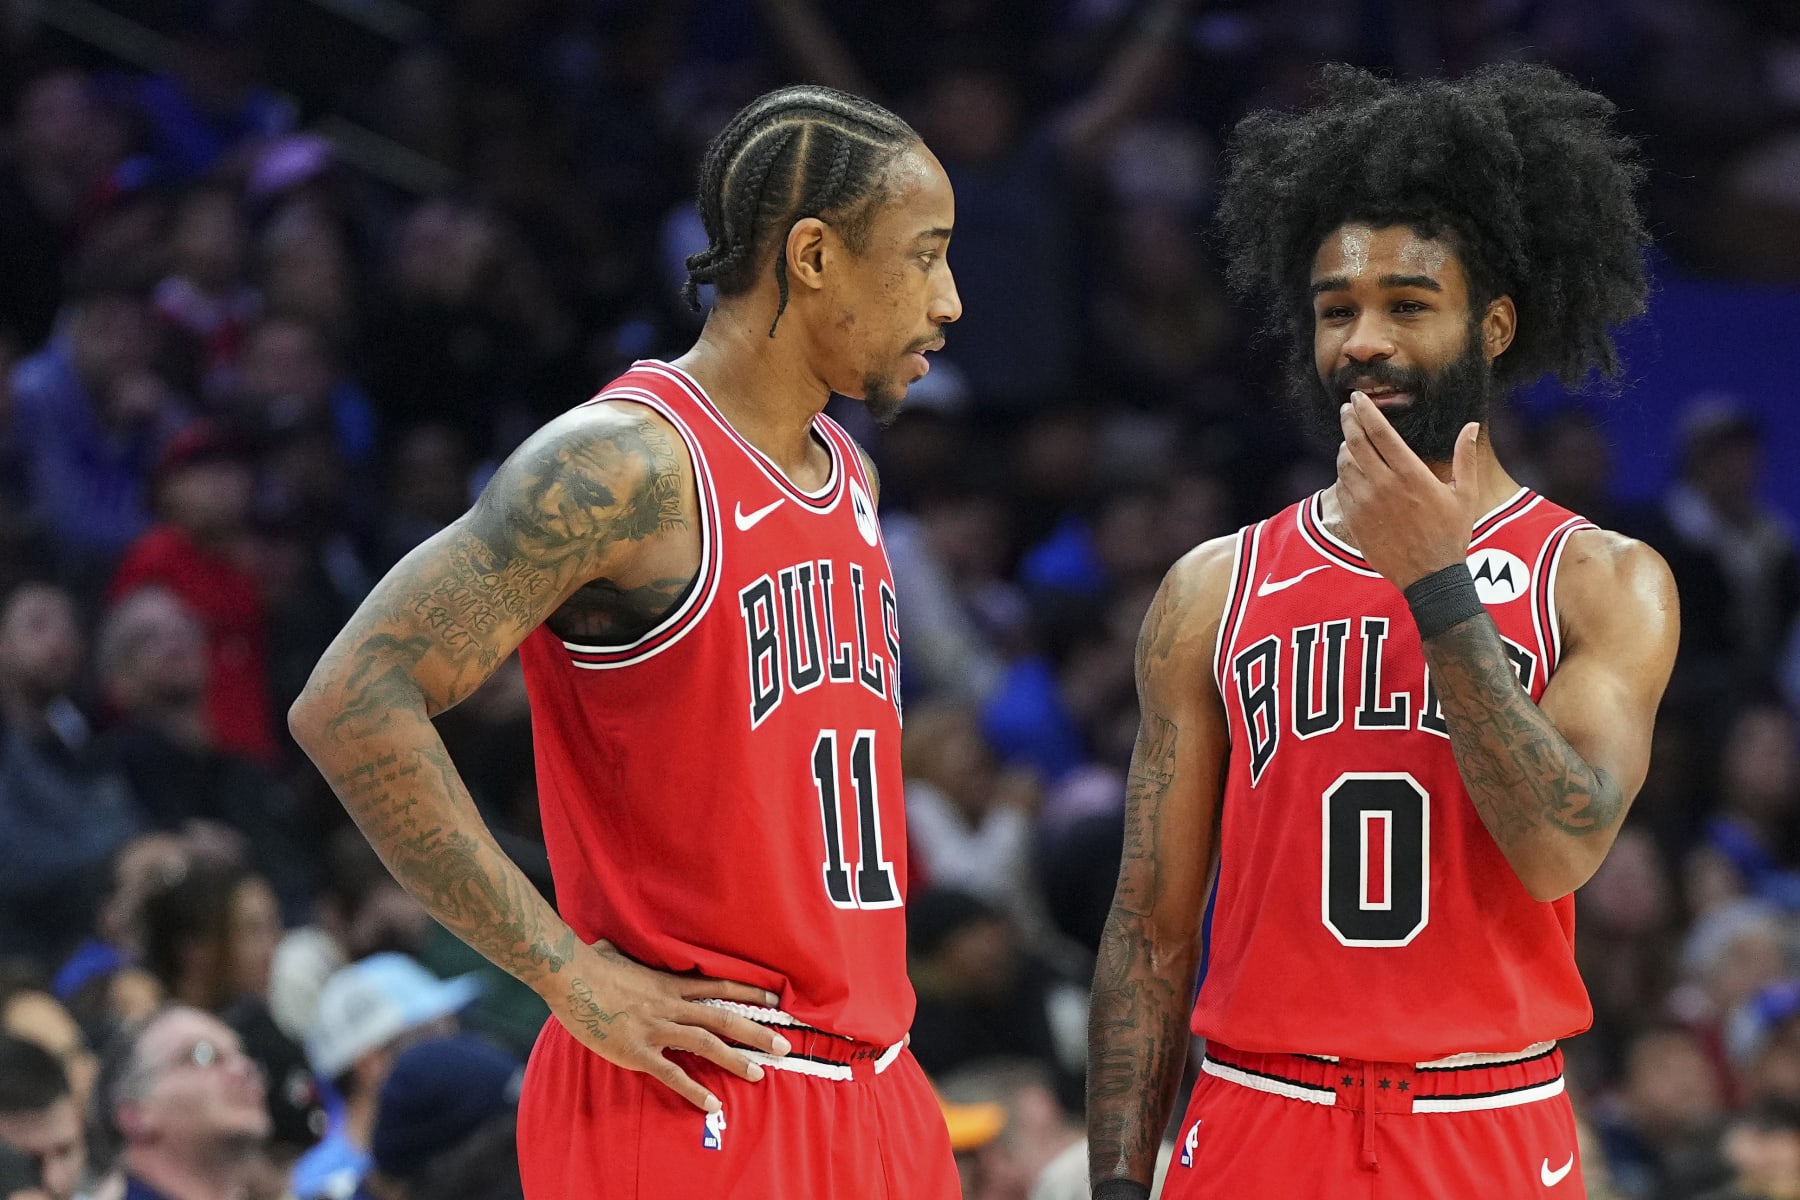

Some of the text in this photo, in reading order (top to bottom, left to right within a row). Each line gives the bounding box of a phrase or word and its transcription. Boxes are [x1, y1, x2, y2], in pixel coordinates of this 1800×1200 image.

[739, 560, 902, 731] BULLS
[1233, 616, 1537, 789] BUL
[811, 729, 903, 910] 11
[1322, 772, 1430, 947] 0
